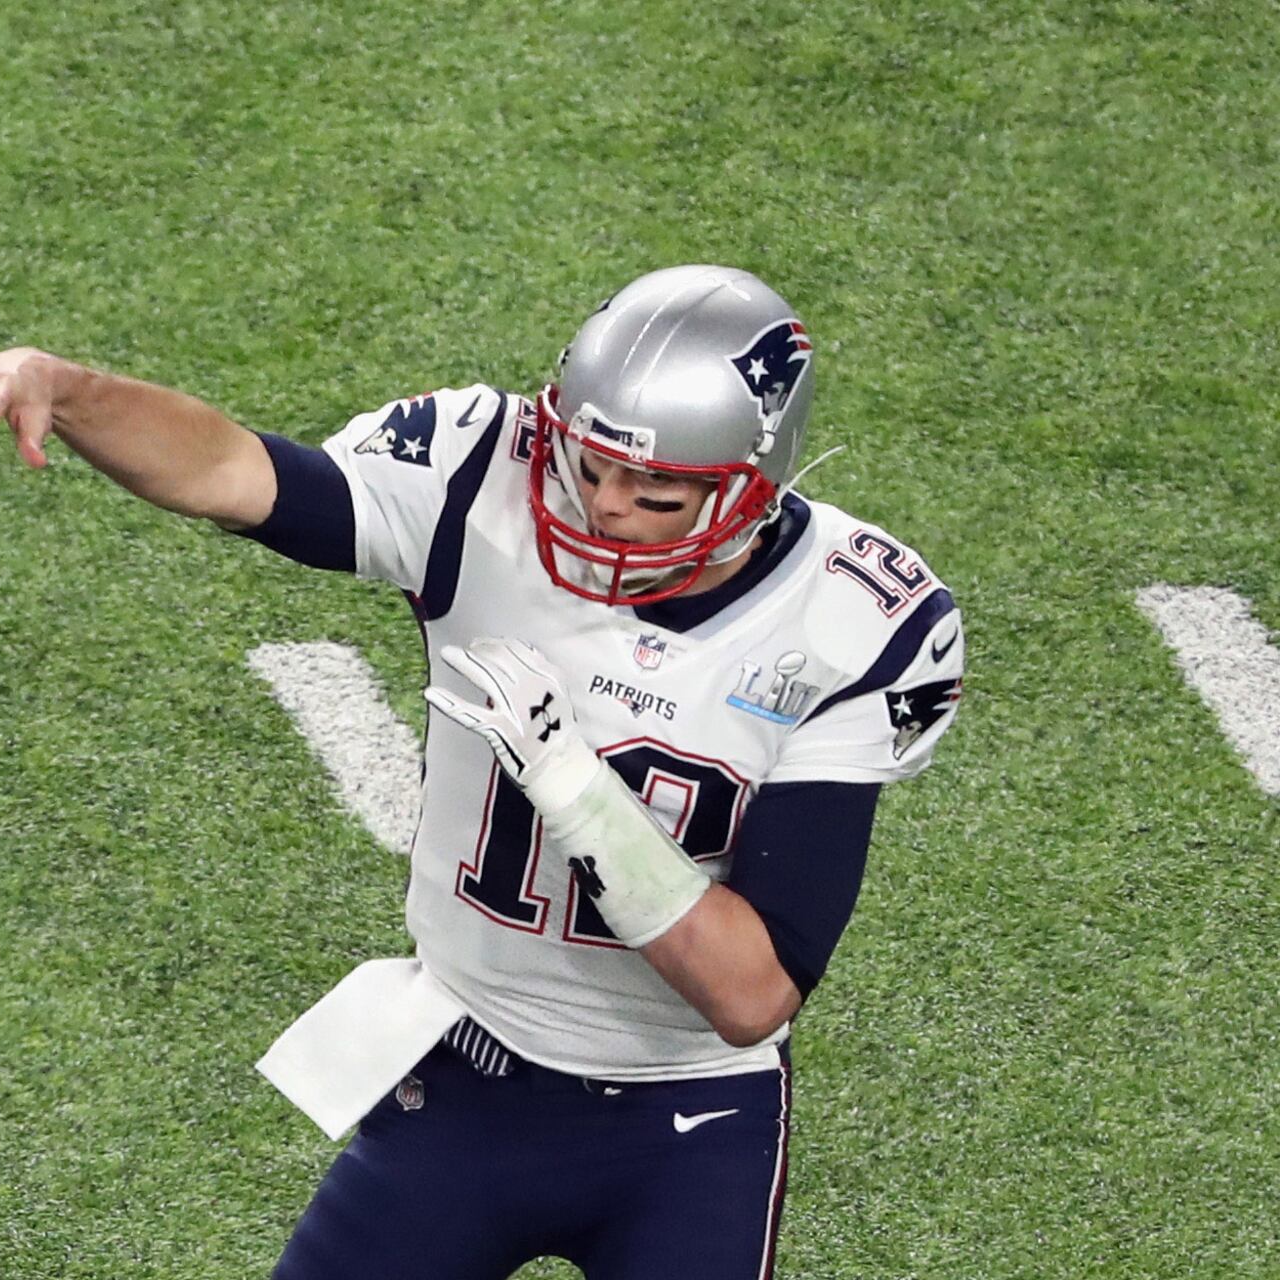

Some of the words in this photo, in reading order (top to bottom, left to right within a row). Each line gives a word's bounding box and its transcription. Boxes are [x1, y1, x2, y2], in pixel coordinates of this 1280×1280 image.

[825, 528, 932, 619] 12
[588, 674, 678, 721] PATRIOTS
[454, 735, 751, 950] 12
